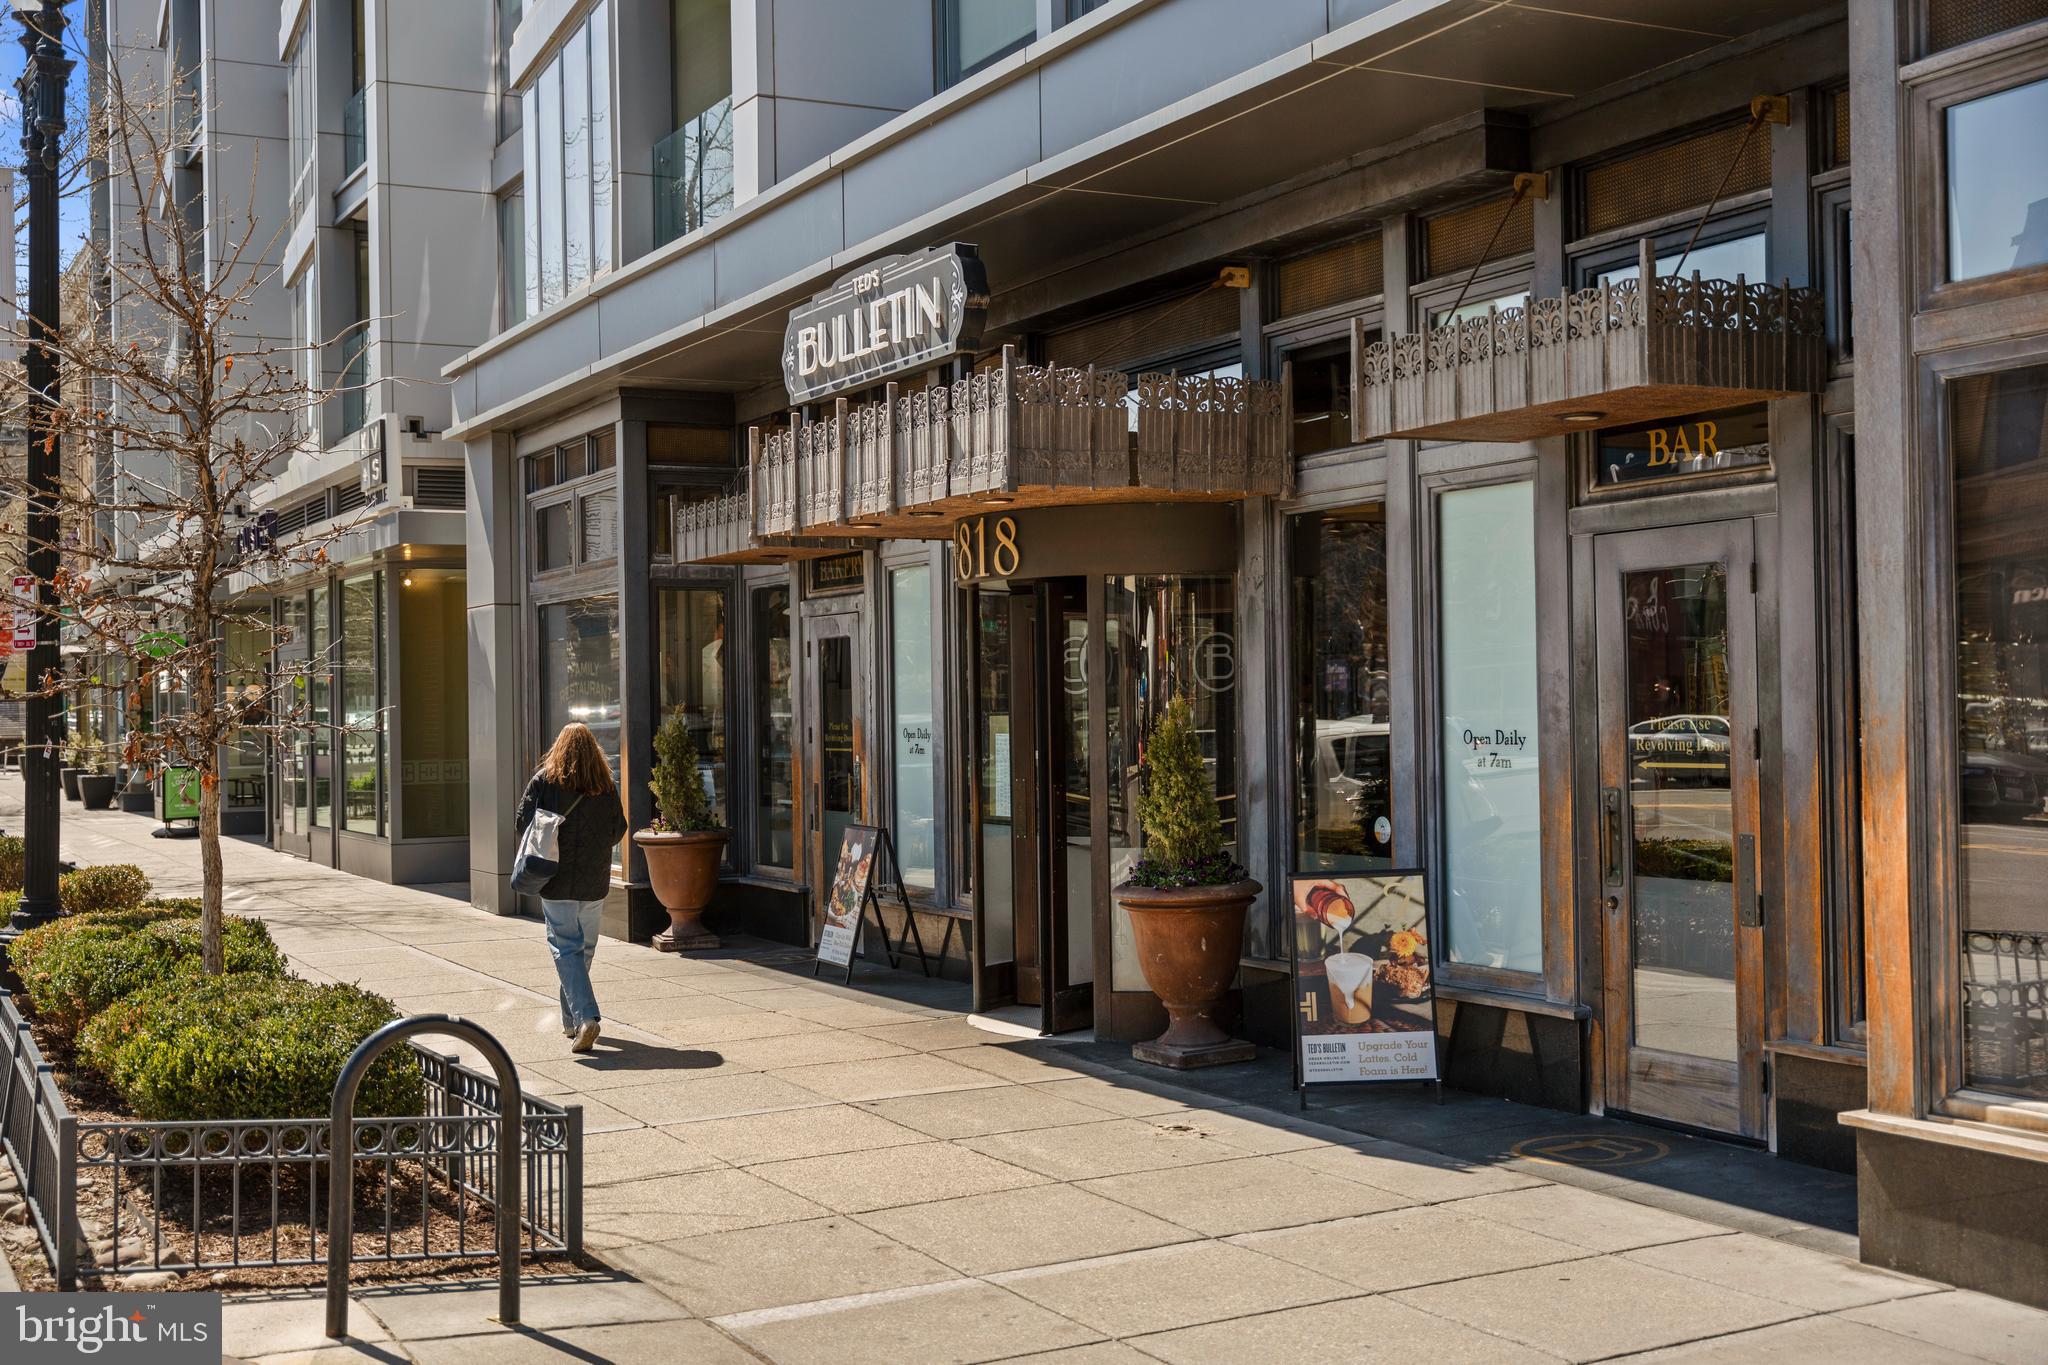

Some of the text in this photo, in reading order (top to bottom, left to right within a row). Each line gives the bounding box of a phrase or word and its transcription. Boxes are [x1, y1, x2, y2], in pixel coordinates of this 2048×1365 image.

[851, 269, 880, 296] TED'S
[797, 276, 942, 377] BULLETIN
[1646, 420, 1720, 467] BAR
[560, 680, 614, 705] RESTAURANT
[1649, 716, 1686, 730] Please
[902, 728, 932, 743] Open Daily
[1463, 729, 1527, 751] Open Daily
[1636, 735, 1726, 756] Revolving Door
[1477, 752, 1512, 769] at 7am
[1307, 1042, 1346, 1055] TED'S BULLETIN
[1358, 1040, 1429, 1052] Upgrade Your
[1393, 1052, 1418, 1063] Cold
[1359, 1064, 1429, 1076] Foam is Here!
